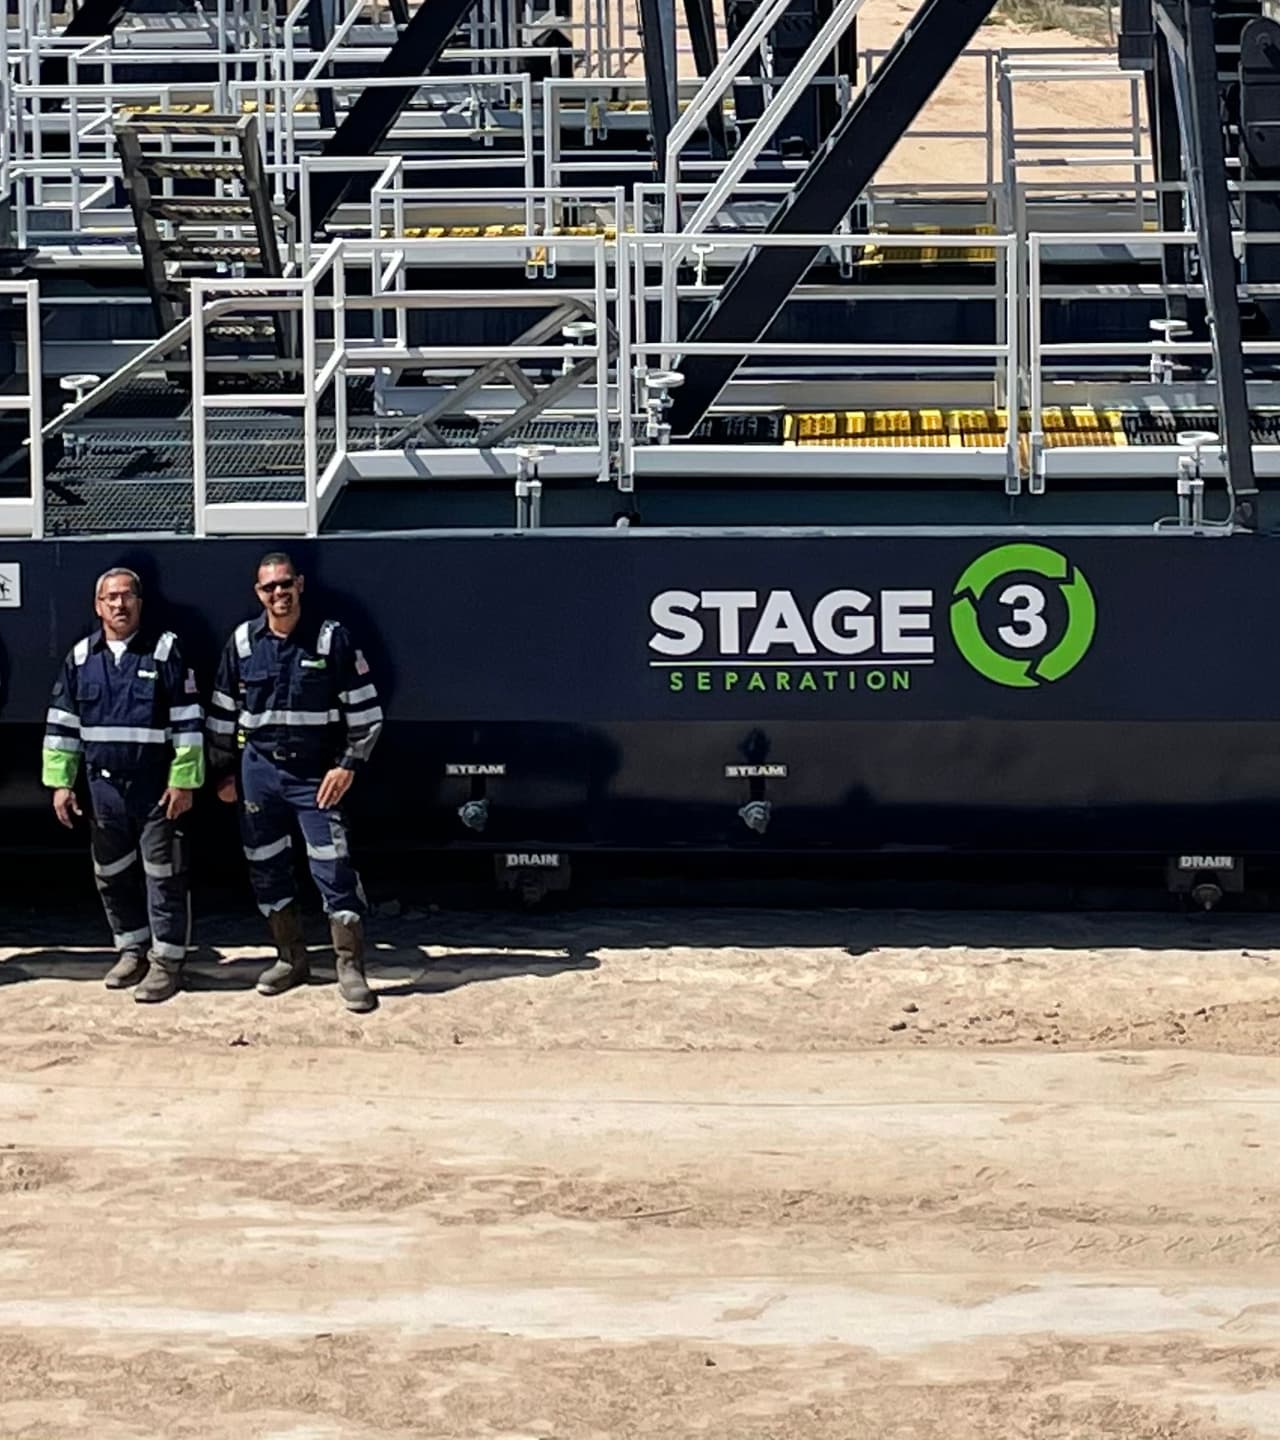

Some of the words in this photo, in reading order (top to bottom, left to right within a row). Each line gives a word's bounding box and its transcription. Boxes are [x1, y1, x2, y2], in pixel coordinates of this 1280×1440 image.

[648, 588, 935, 655] STAGE
[997, 583, 1049, 649] 3
[669, 670, 912, 692] SEPARATION
[505, 853, 560, 867] DRAIN
[1179, 855, 1234, 869] DRAIN
